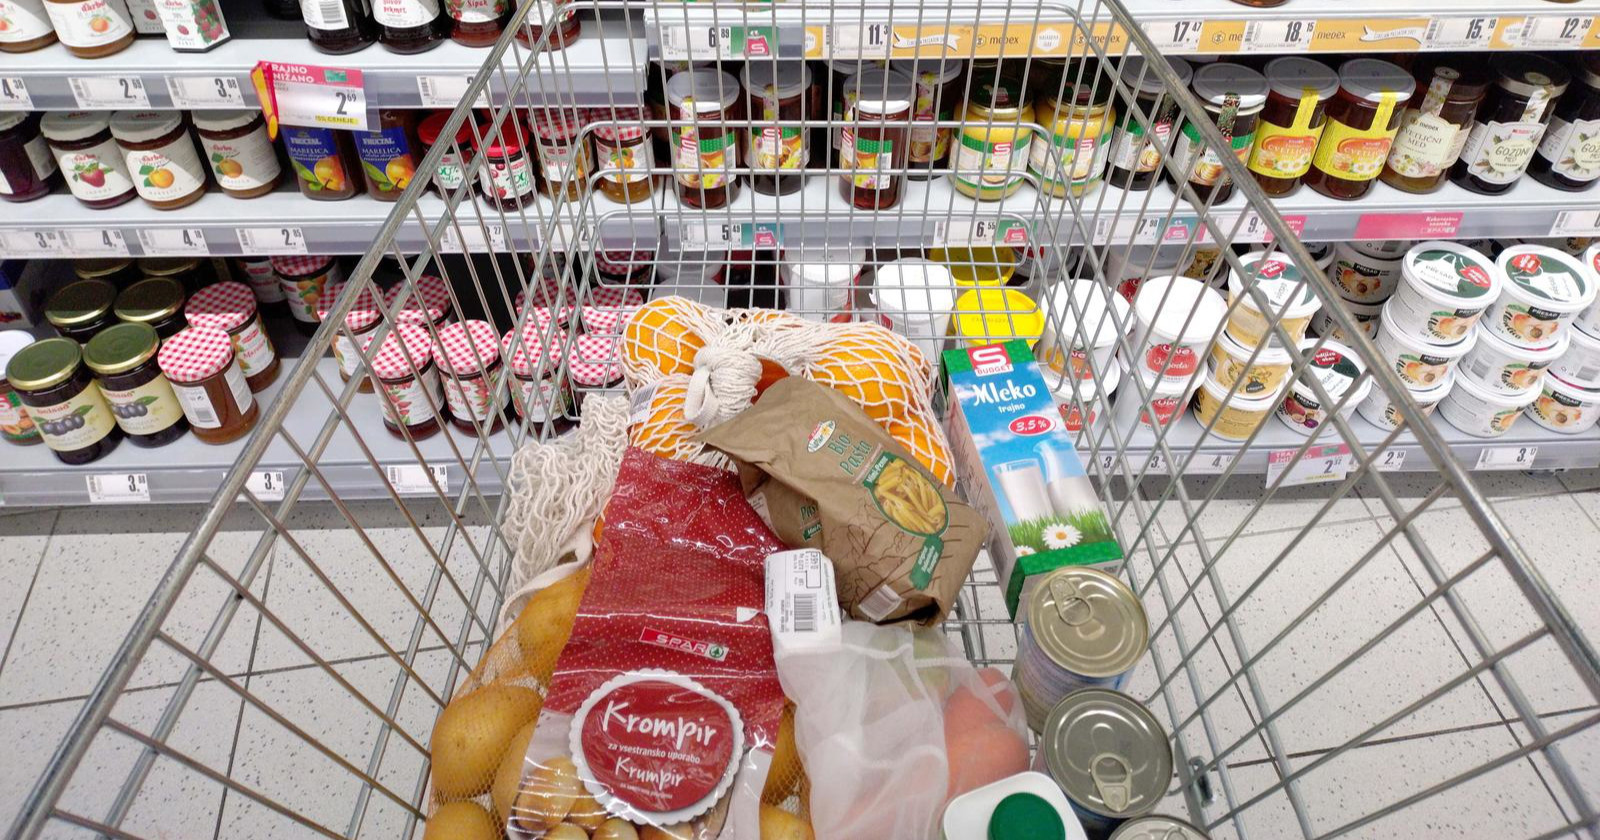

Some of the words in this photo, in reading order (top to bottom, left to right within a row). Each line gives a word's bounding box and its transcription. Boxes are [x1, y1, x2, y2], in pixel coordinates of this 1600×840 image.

[977, 365, 1011, 375] BUDGET
[972, 379, 1037, 407] Mleko
[998, 403, 1026, 414] trajno
[839, 440, 873, 476] Pasta
[656, 634, 706, 655] SPAR
[602, 700, 717, 750] Krompir
[619, 744, 666, 758] vsestransko
[615, 756, 686, 791] Krumpir
